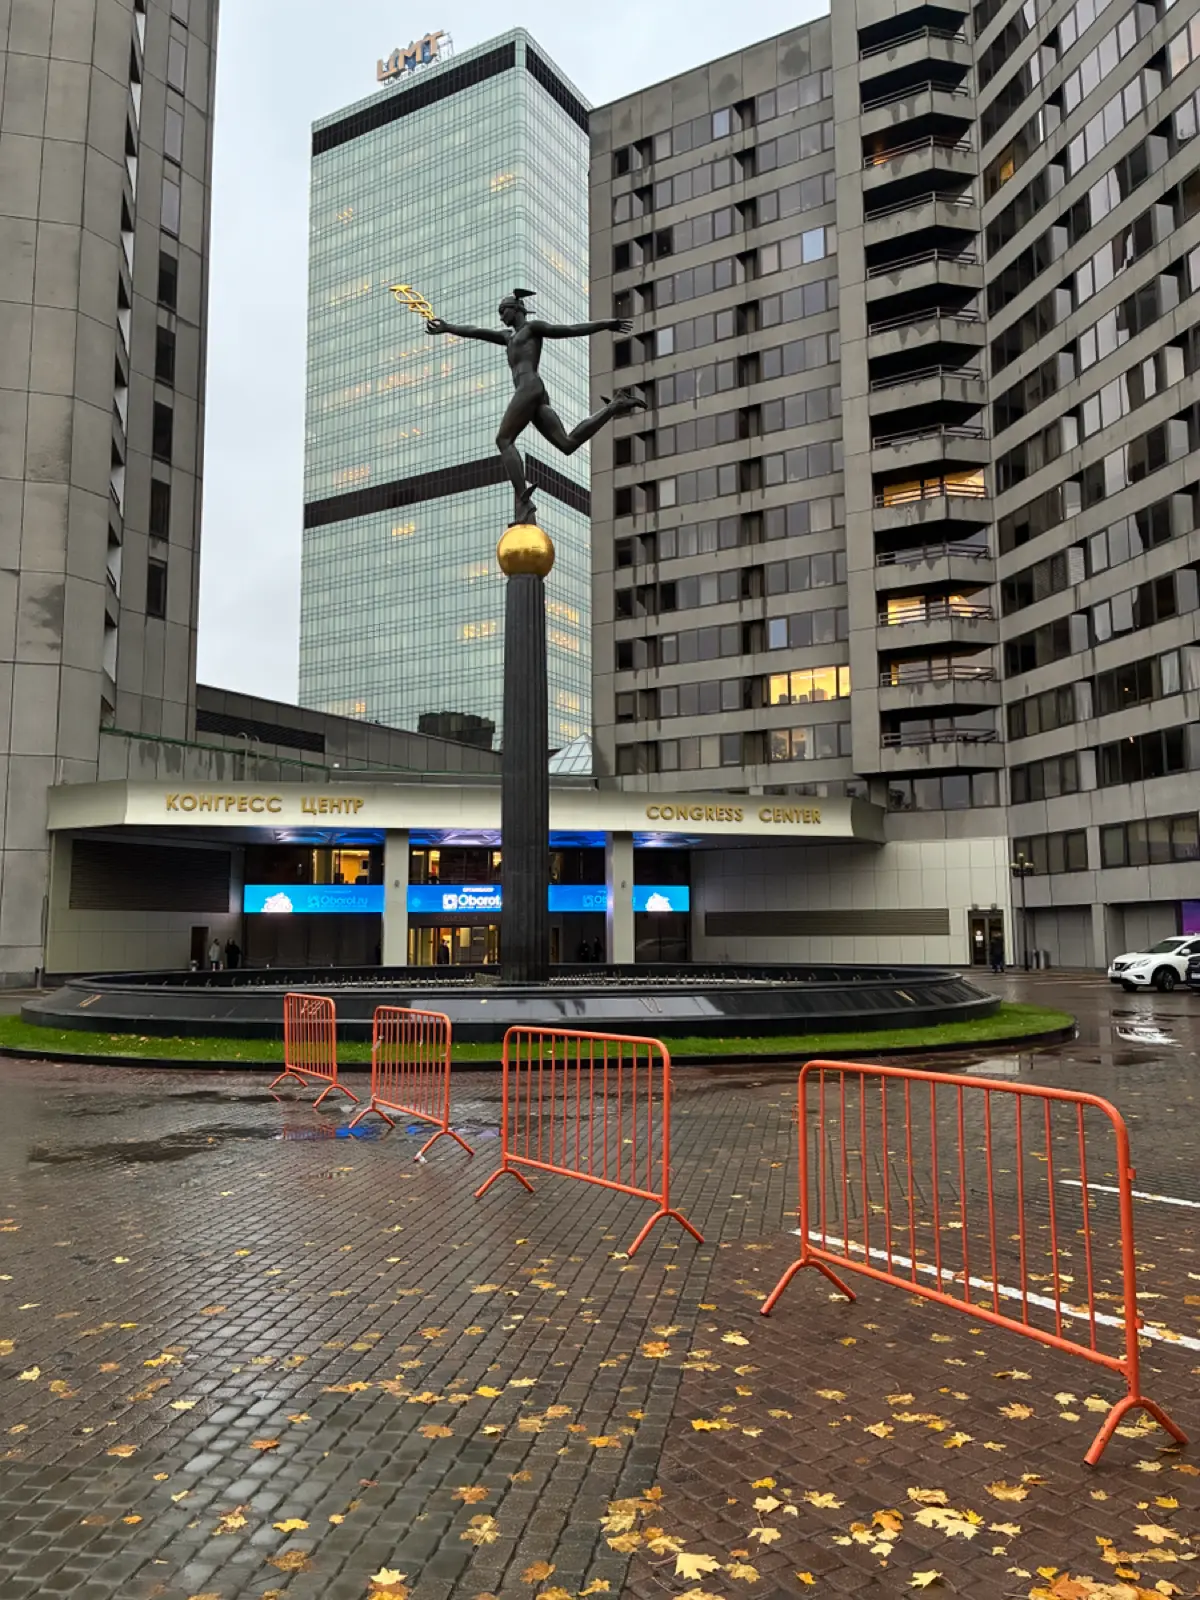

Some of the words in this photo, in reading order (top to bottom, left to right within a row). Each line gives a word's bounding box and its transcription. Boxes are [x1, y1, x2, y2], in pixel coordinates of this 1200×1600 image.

[377, 30, 443, 80] ЦМТ
[165, 793, 282, 813] КОНГРЕСС
[301, 796, 365, 815] ЦЕНТР
[646, 804, 744, 822] CONGRESS
[758, 807, 821, 825] CENTER
